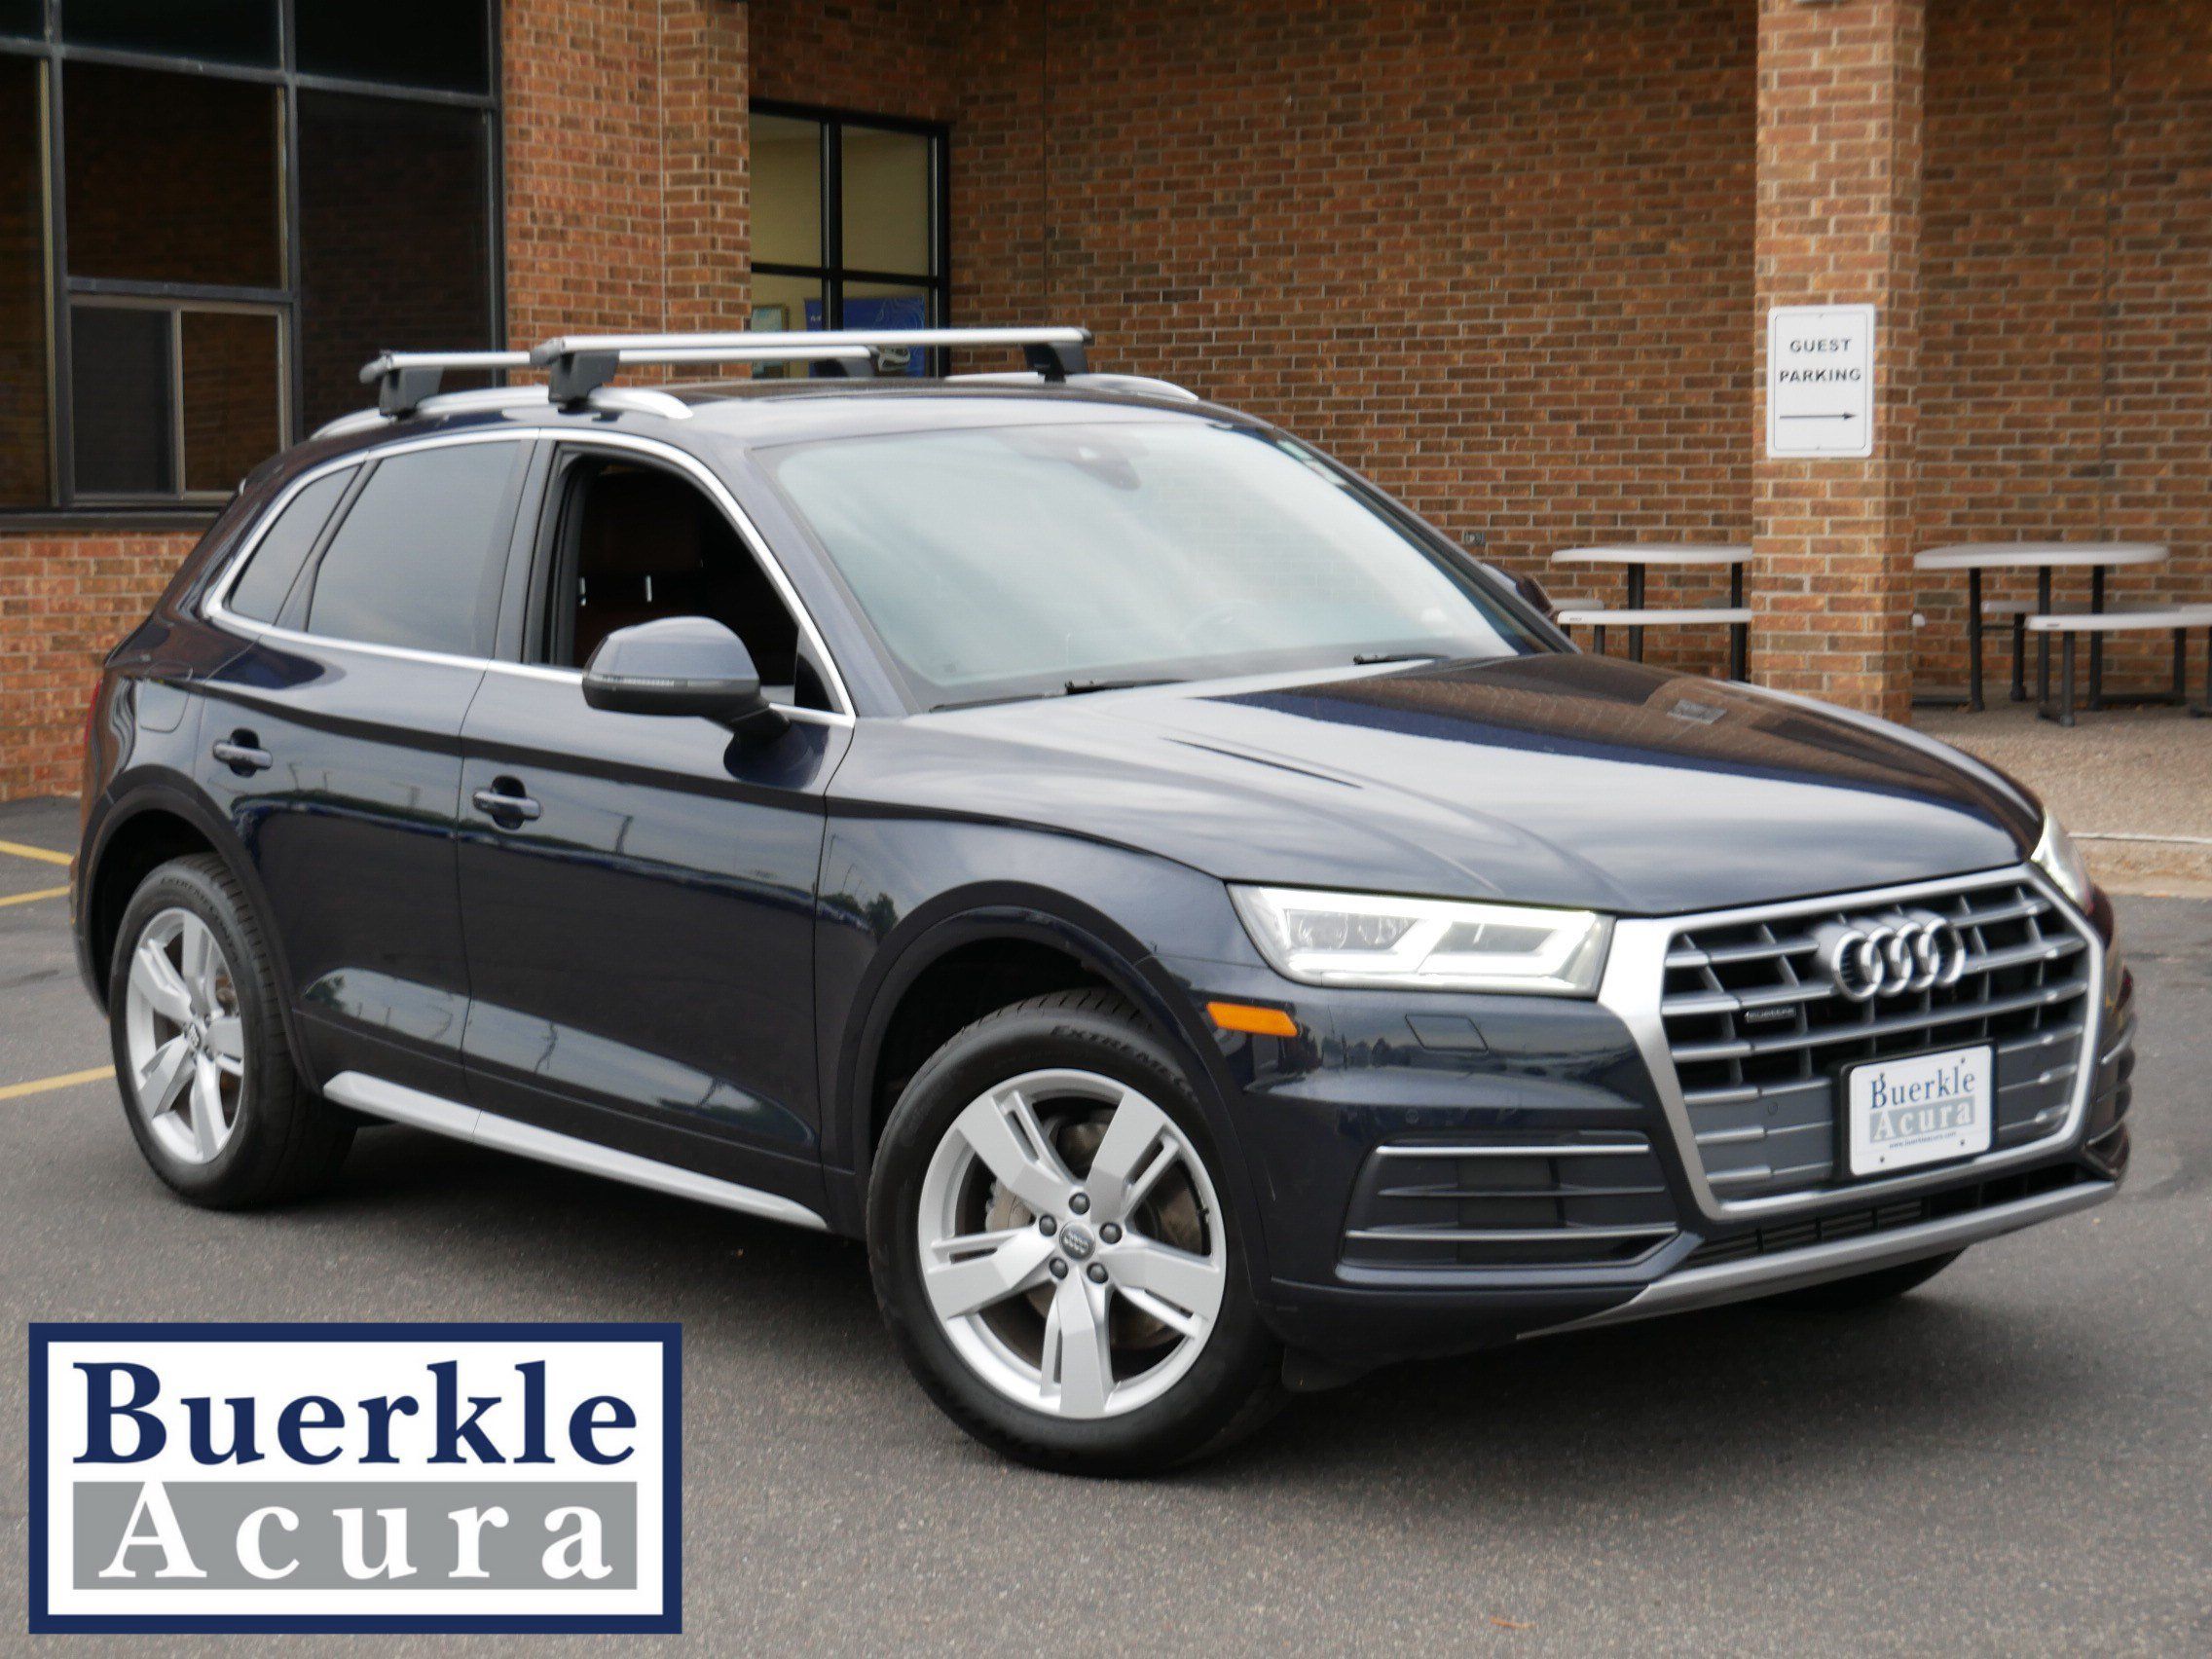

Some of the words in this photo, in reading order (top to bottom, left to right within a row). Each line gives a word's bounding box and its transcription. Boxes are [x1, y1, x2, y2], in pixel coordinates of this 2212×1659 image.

[1789, 338, 1852, 352] GUEST
[1779, 368, 1862, 383] PARKING
[1870, 1067, 1975, 1110] Buerkle
[1872, 1100, 1972, 1141] Acura
